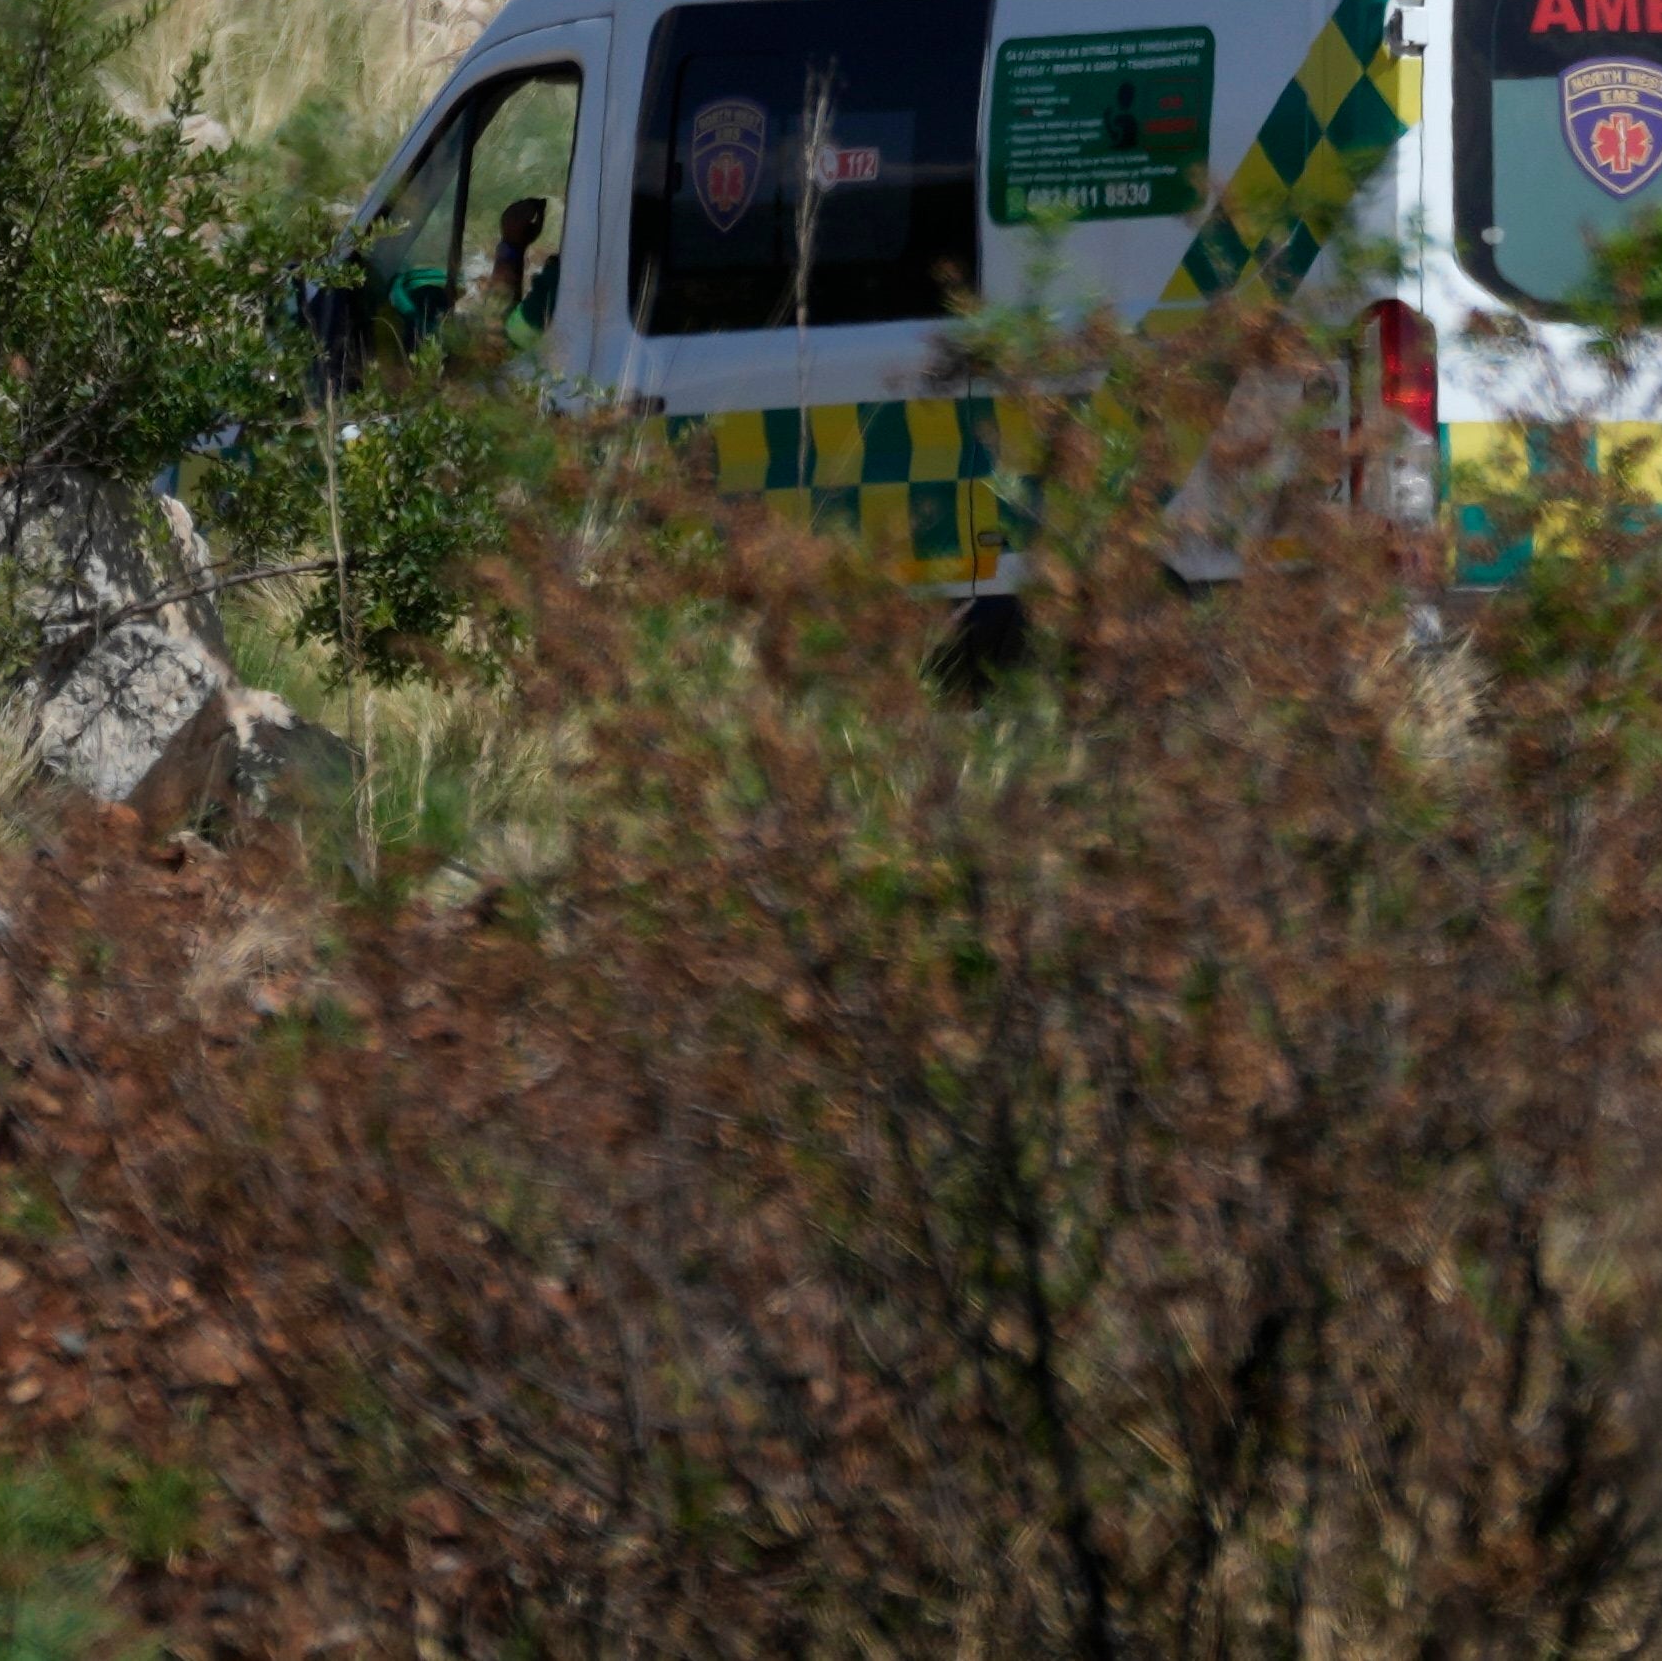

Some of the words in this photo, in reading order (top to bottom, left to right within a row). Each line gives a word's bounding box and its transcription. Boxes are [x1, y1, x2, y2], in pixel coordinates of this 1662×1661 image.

[1571, 70, 1622, 93] NORTH
[1600, 90, 1639, 104] EMS
[847, 152, 876, 178] 112
